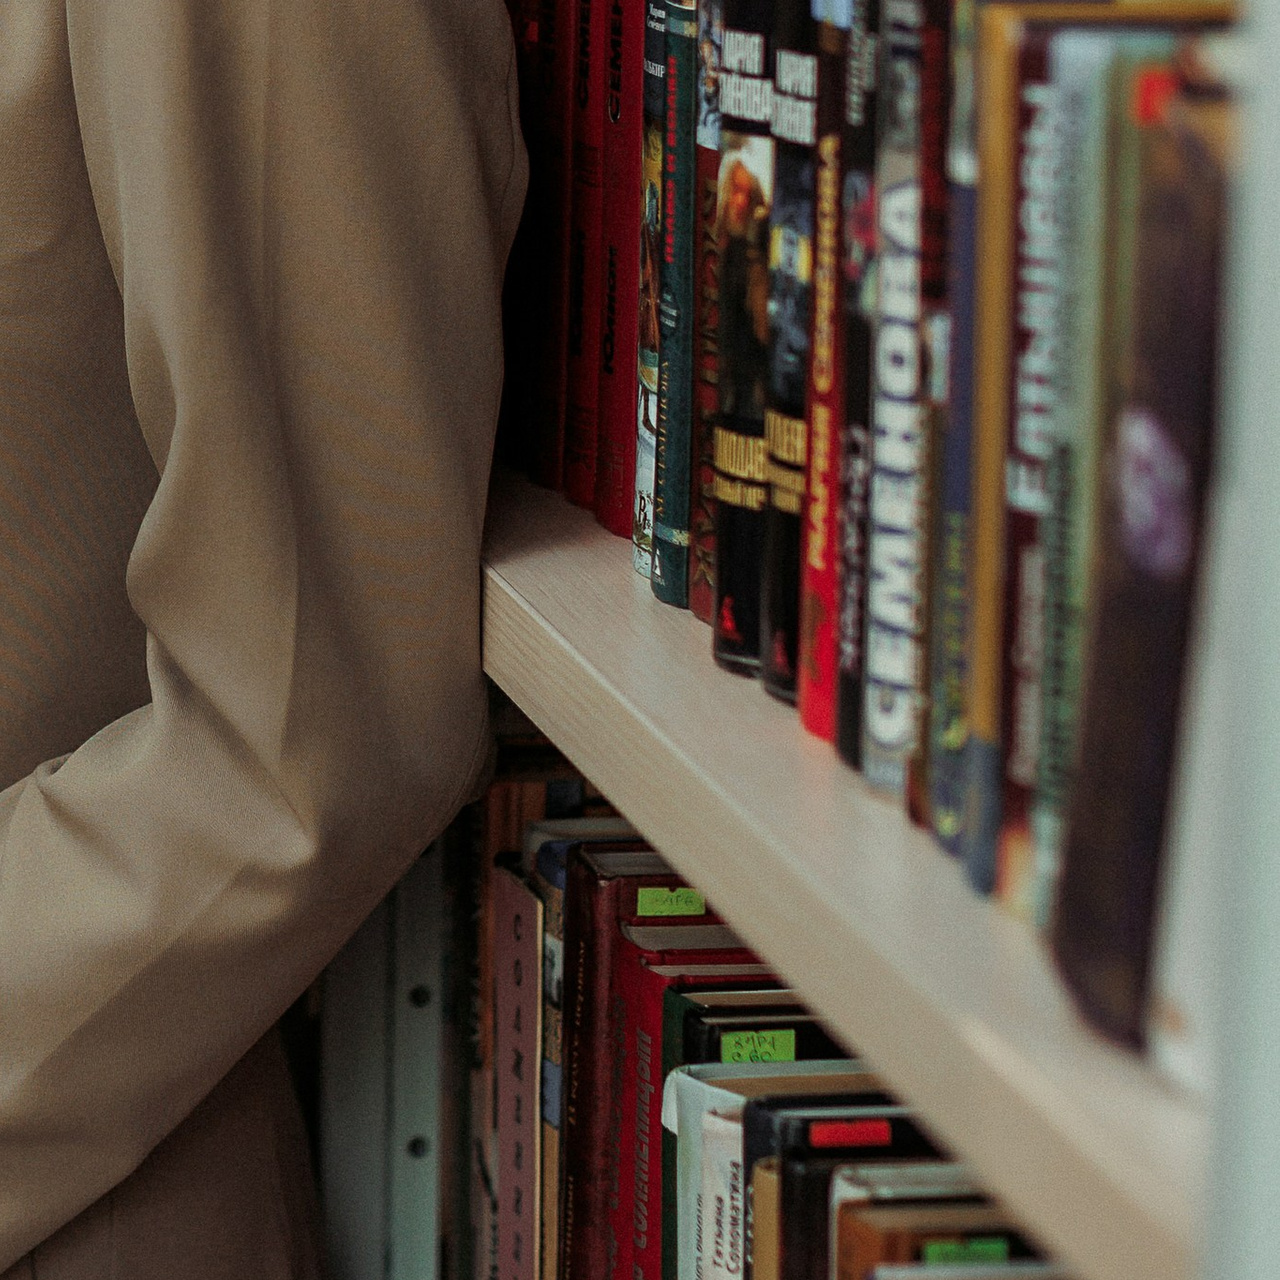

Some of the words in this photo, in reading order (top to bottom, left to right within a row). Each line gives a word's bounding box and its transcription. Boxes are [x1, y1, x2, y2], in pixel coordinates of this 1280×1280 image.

[718, 70, 773, 123] ЕМЕНОВА
[870, 182, 921, 746] СЕМЕНОВА
[633, 1026, 655, 1250] СОЛЖЕНИЦЫН
[711, 1195, 725, 1270] Татьяна
[726, 1159, 741, 1275] Соломатина
